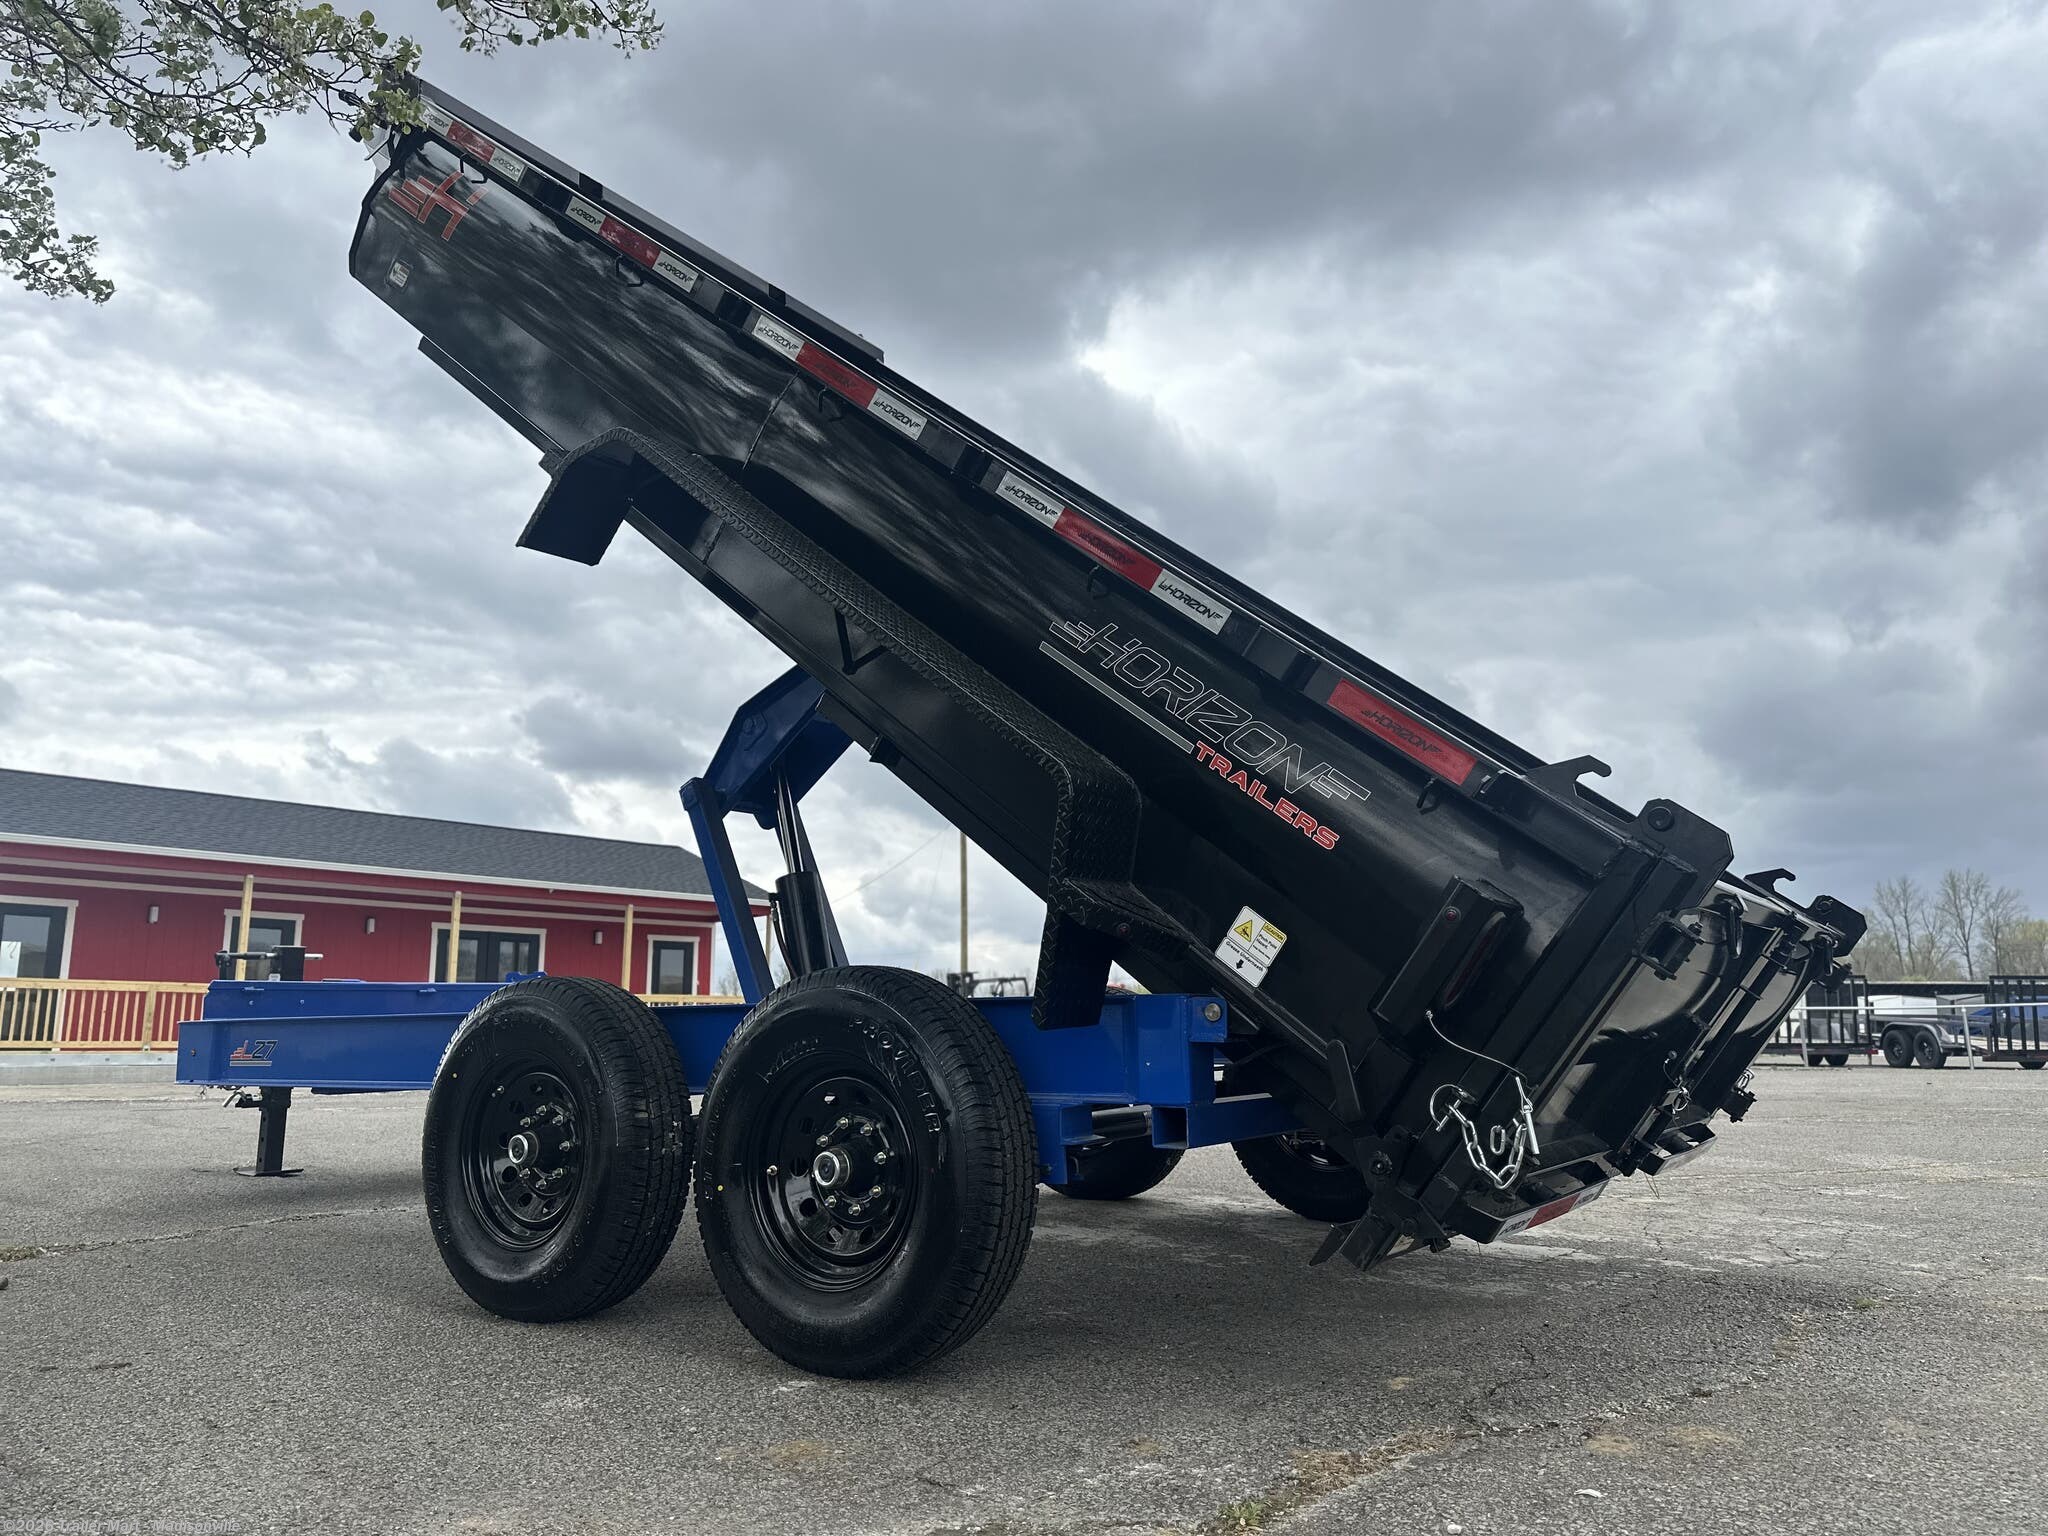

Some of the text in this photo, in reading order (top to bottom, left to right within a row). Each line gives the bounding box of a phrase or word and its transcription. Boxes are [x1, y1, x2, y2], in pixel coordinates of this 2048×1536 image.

[658, 260, 695, 284] HORIZON
[758, 325, 800, 351] HORIZON
[874, 398, 921, 429] HORIZON
[1004, 484, 1058, 517] HORIZON
[1158, 578, 1223, 621] HORIZON
[1048, 620, 1372, 802] HORIZON
[1361, 709, 1444, 753] HORIZON
[1195, 740, 1341, 851] TRAILERS
